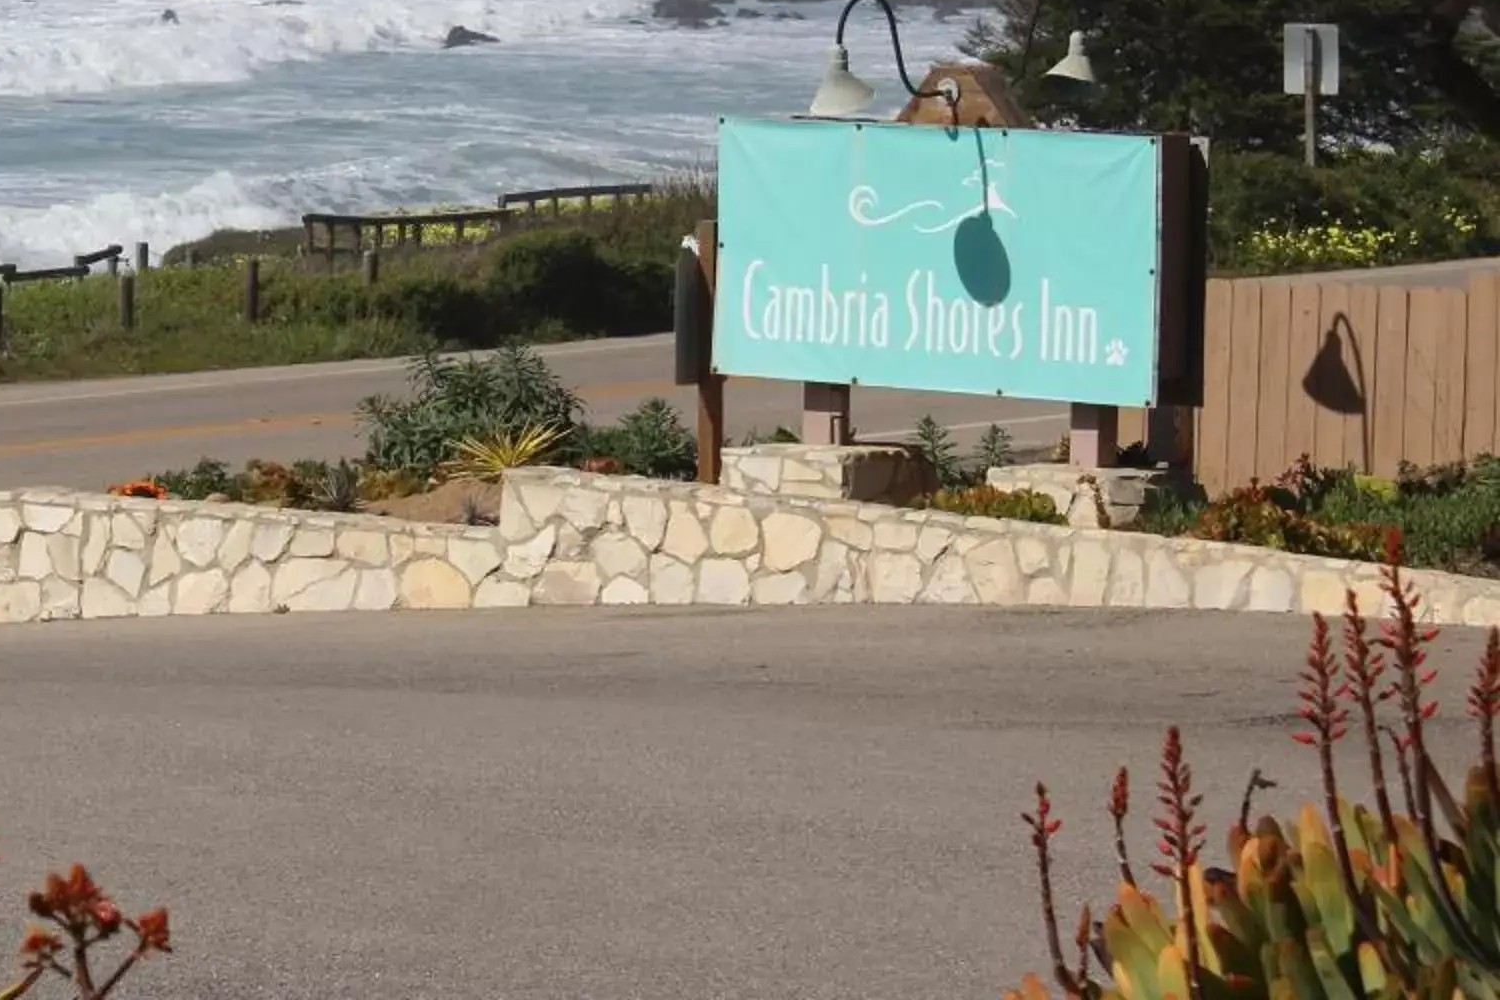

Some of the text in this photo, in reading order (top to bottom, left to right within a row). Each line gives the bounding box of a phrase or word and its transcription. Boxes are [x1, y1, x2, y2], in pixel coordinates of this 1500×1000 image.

[742, 259, 1099, 365] Cambria Shores Inn
